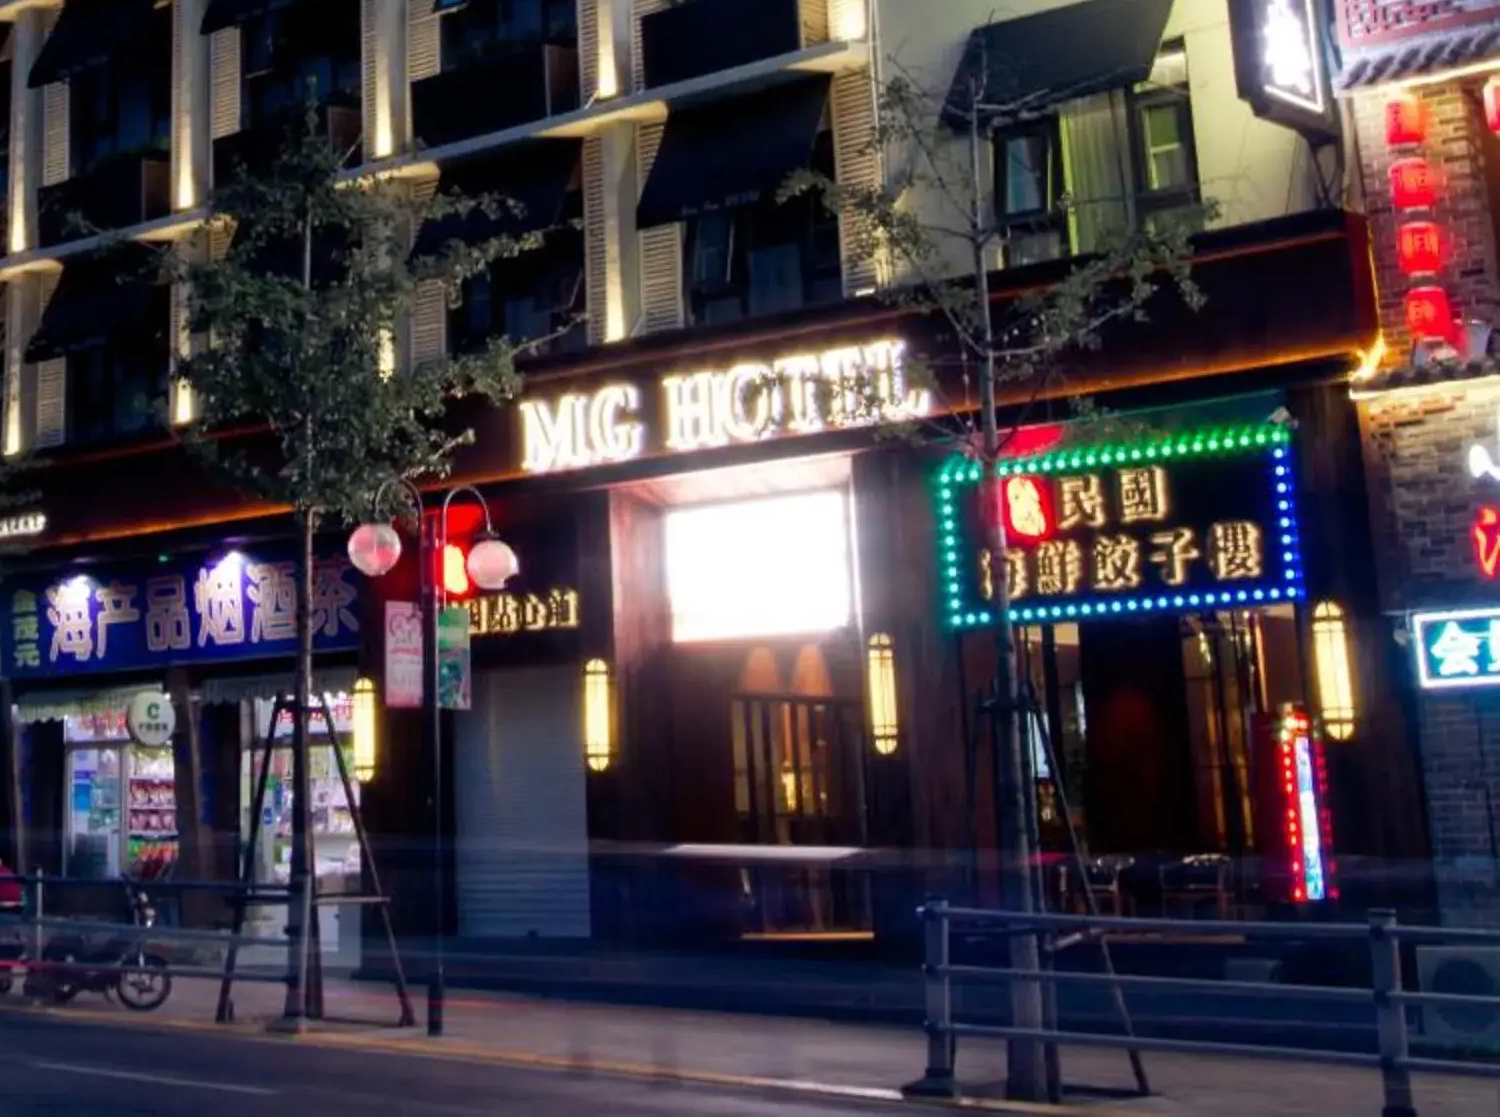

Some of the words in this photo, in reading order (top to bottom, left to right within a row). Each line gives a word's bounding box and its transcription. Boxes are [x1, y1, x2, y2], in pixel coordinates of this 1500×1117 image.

[519, 383, 646, 473] MG
[663, 338, 932, 452] HOTEL
[1430, 620, 1500, 676] 会
